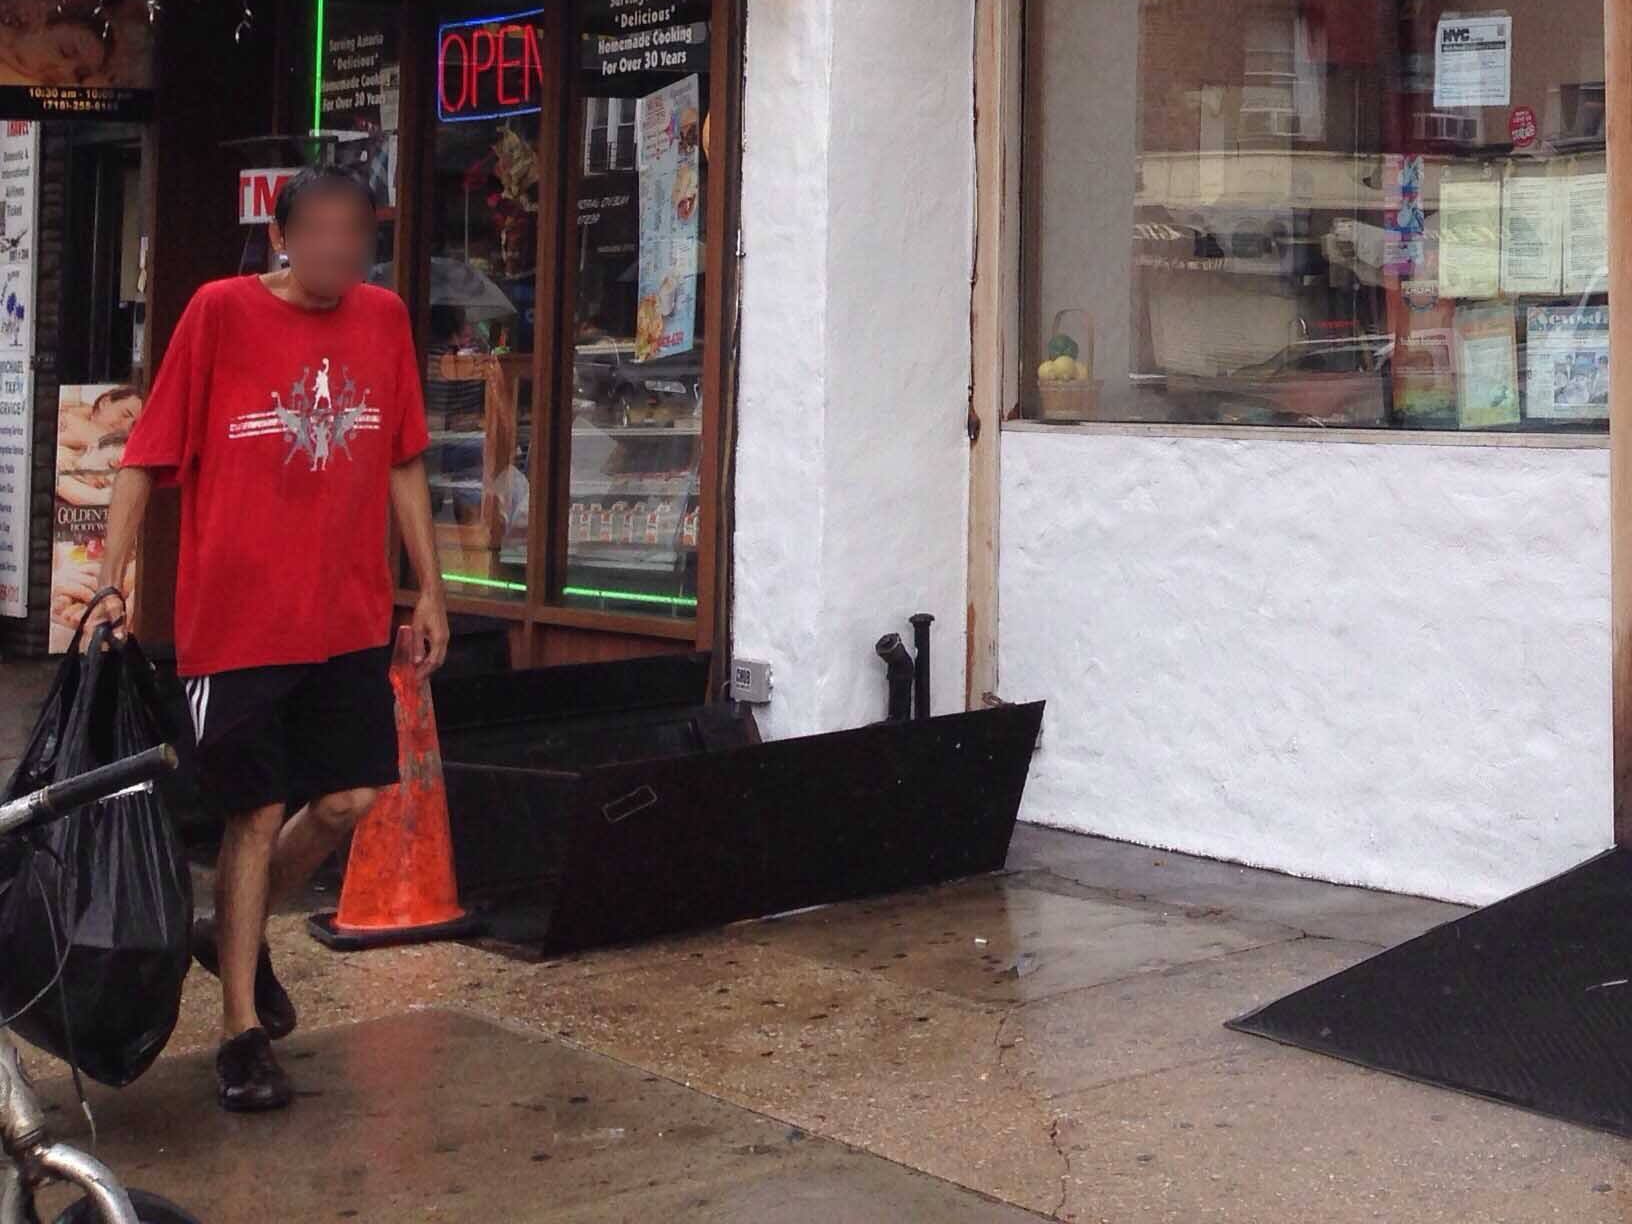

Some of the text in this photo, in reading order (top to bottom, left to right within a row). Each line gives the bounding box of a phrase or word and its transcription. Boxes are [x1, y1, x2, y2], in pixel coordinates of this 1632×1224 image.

[598, 26, 692, 55] Homemade Cooking
[1443, 27, 1470, 43] NYC
[440, 23, 543, 113] OPEN
[602, 50, 687, 76] For Over 30 Years
